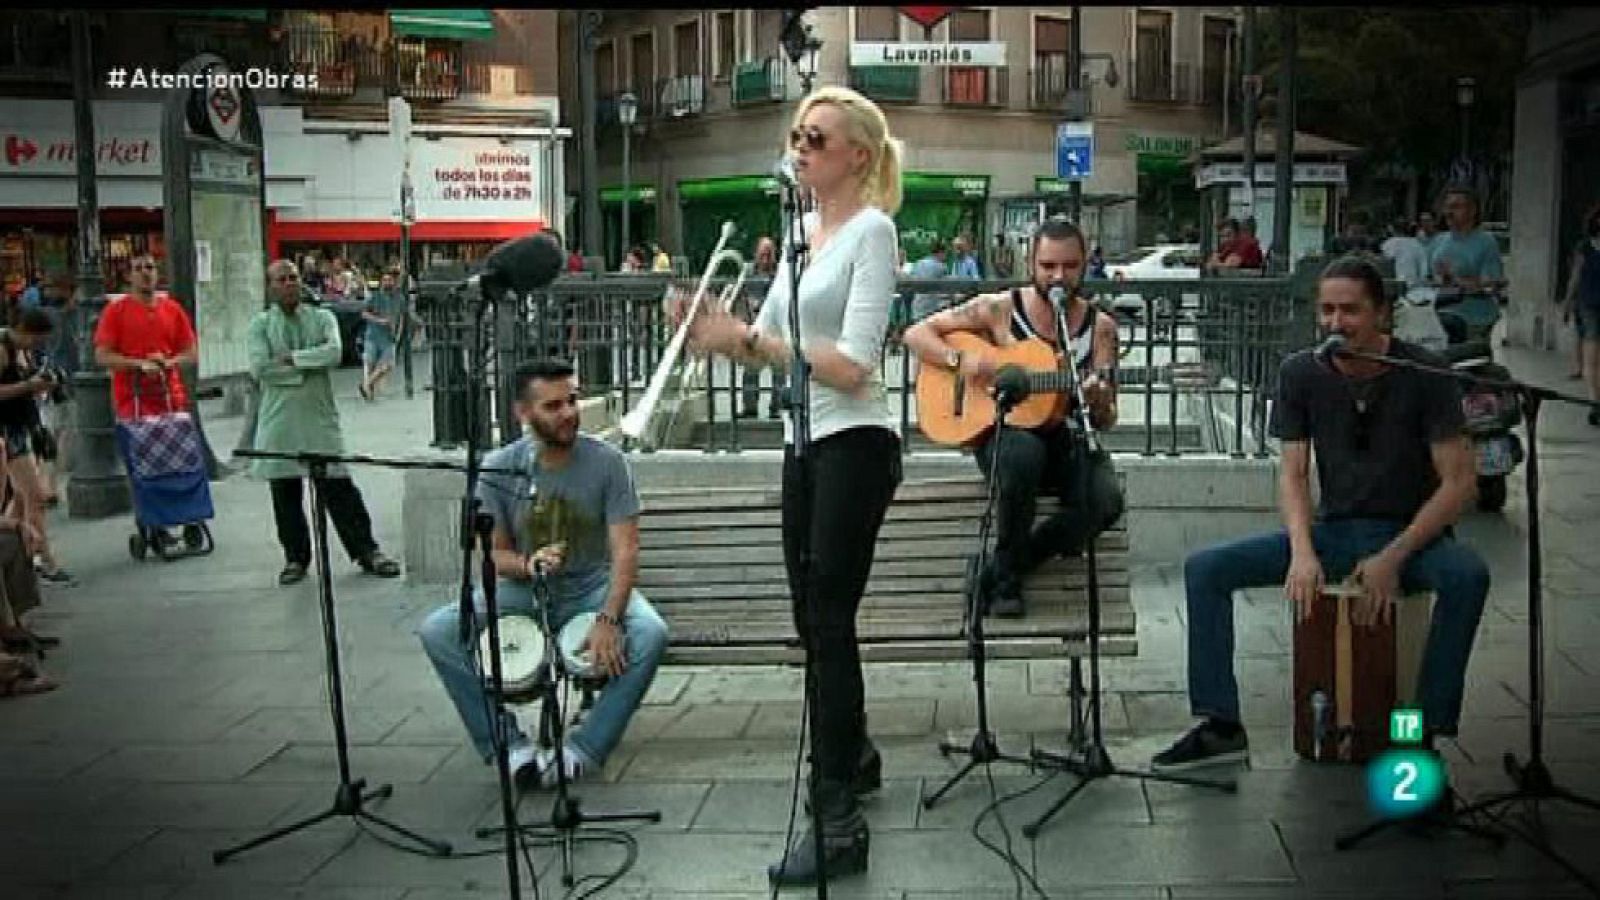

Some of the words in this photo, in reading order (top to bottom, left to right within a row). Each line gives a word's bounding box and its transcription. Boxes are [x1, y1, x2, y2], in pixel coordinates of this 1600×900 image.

[882, 44, 972, 64] Lavapiés
[47, 136, 150, 164] mrket
[435, 168, 476, 182] todos
[479, 168, 499, 182] los
[443, 186, 461, 200] de
[465, 185, 500, 200] 7h30
[503, 188, 512, 200] a
[513, 186, 532, 200] 2h
